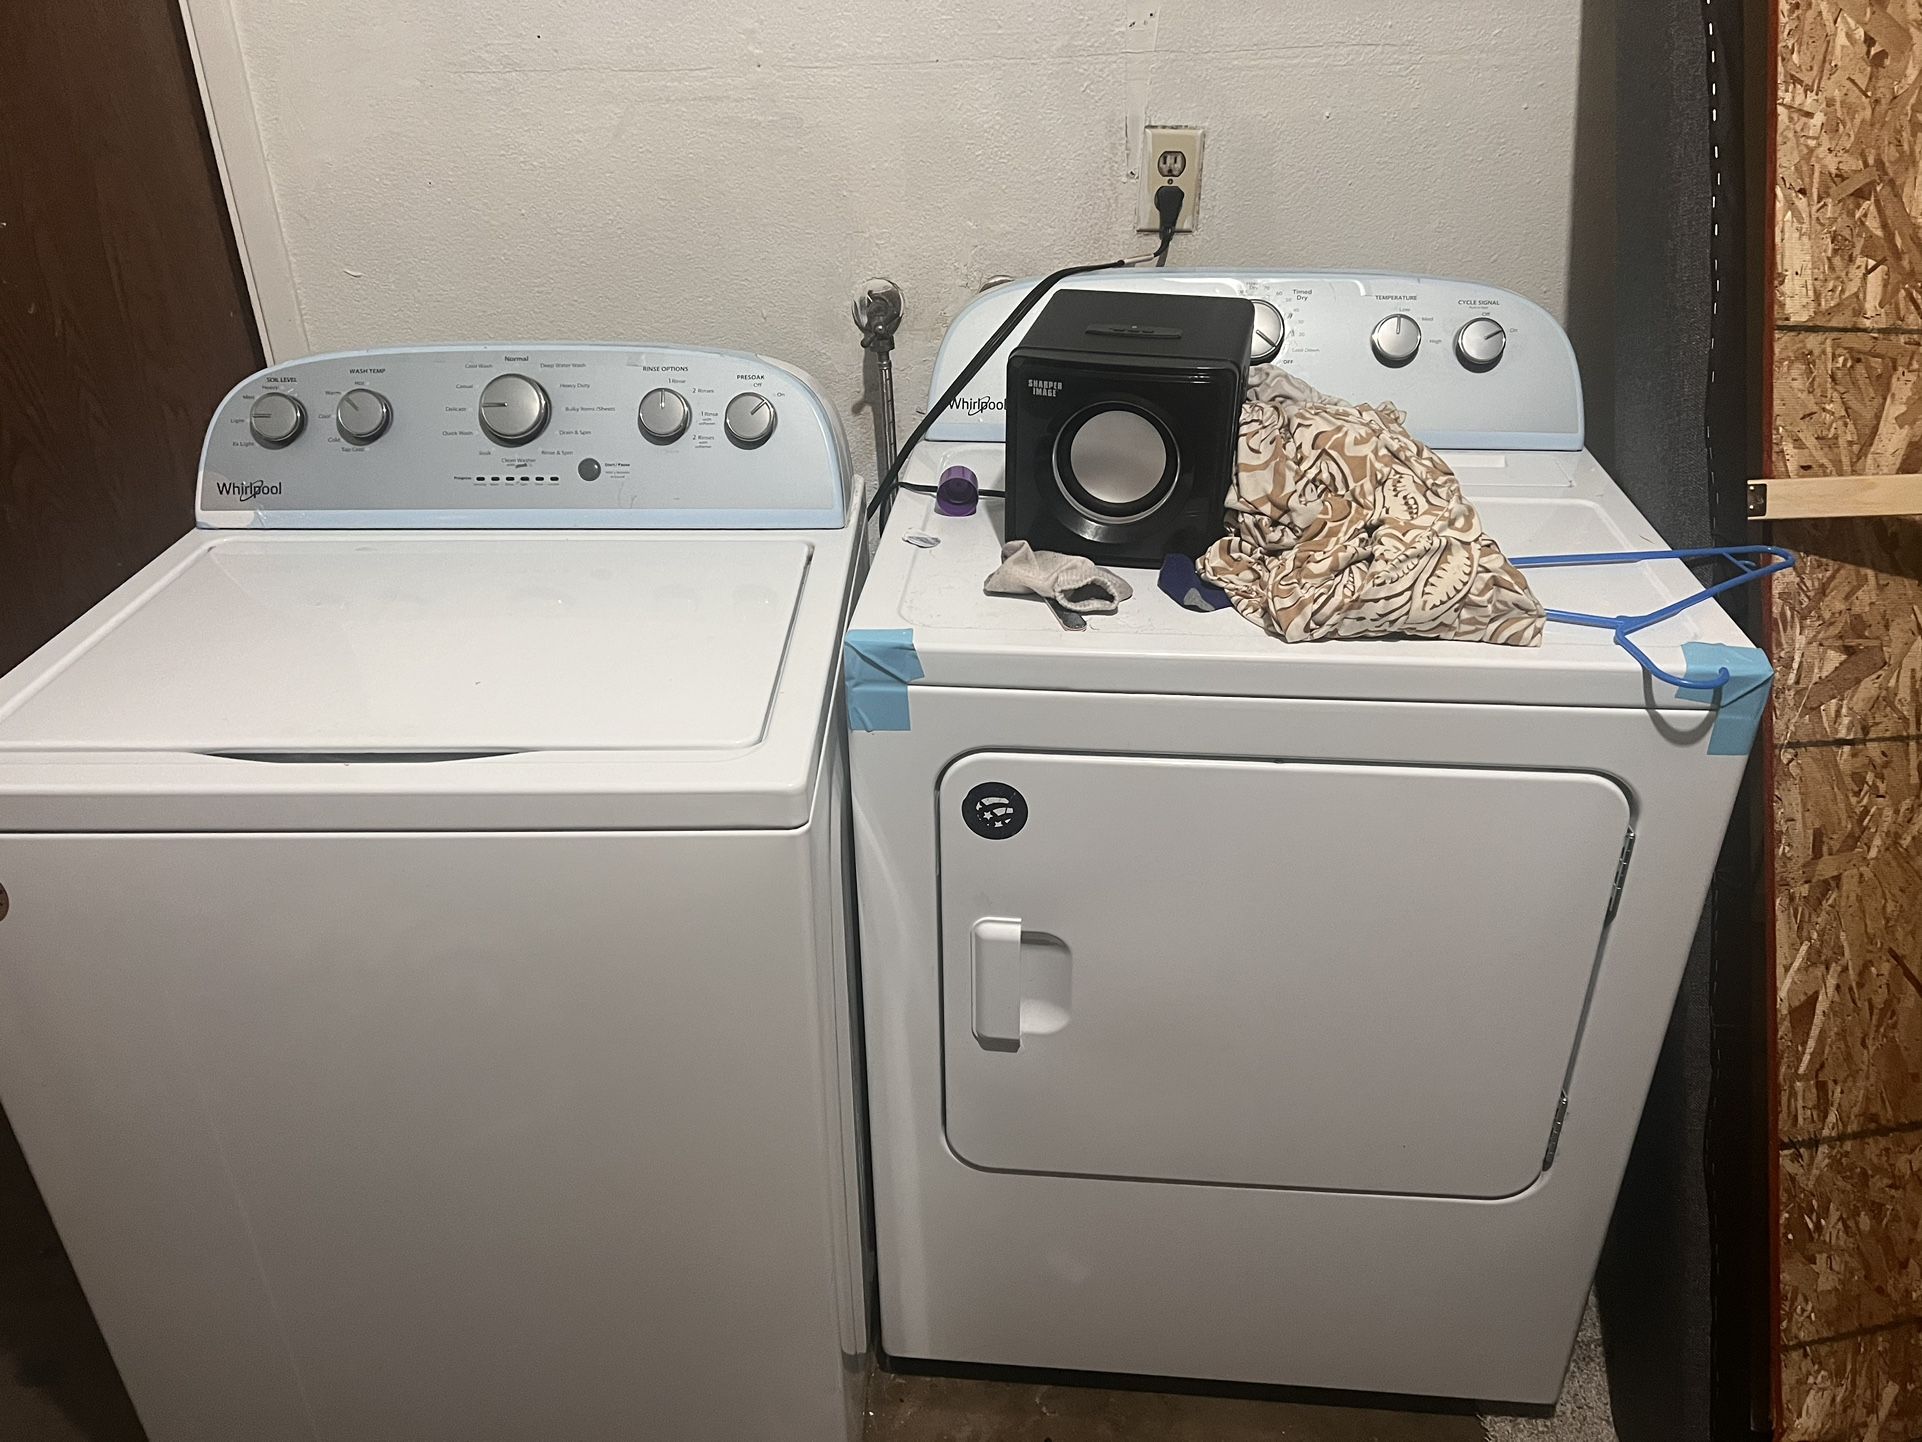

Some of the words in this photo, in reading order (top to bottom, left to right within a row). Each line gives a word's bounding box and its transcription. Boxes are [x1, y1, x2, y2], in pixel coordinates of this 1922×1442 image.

[1028, 379, 1063, 390] SHARPER
[1032, 388, 1057, 397] IMAGE
[948, 396, 1007, 416] Whirlpool
[216, 480, 282, 501] Whirlpool
